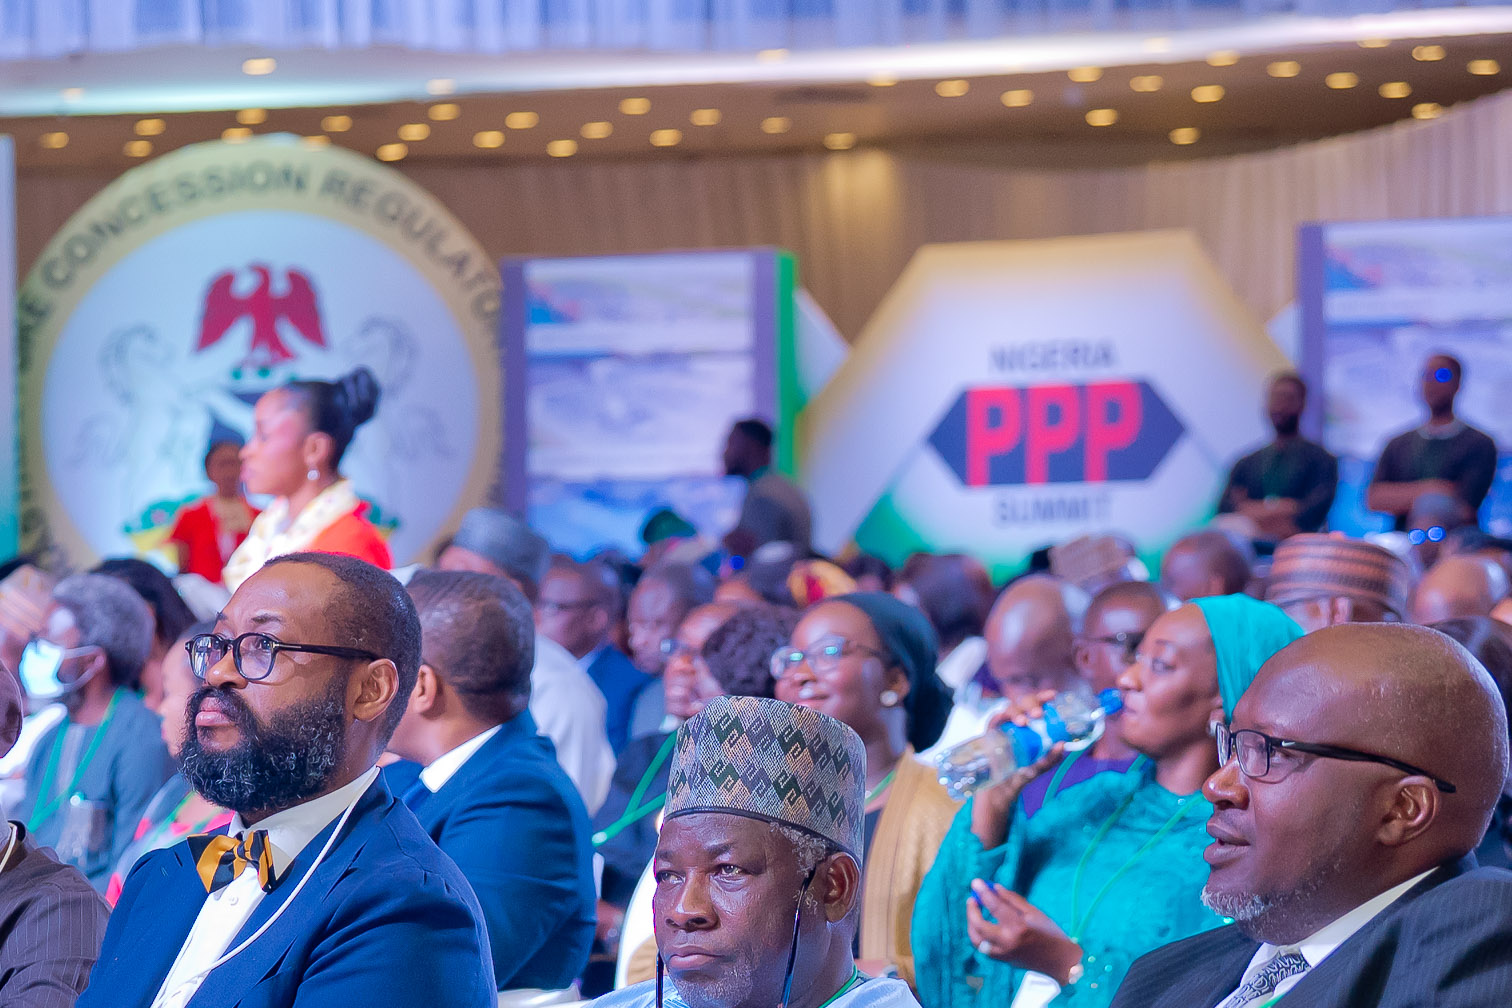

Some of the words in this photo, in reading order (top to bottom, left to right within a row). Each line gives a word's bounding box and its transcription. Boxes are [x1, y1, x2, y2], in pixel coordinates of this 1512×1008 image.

[40, 160, 306, 289] CONCESSION
[316, 167, 500, 320] REGULATO
[965, 381, 1142, 487] PPP
